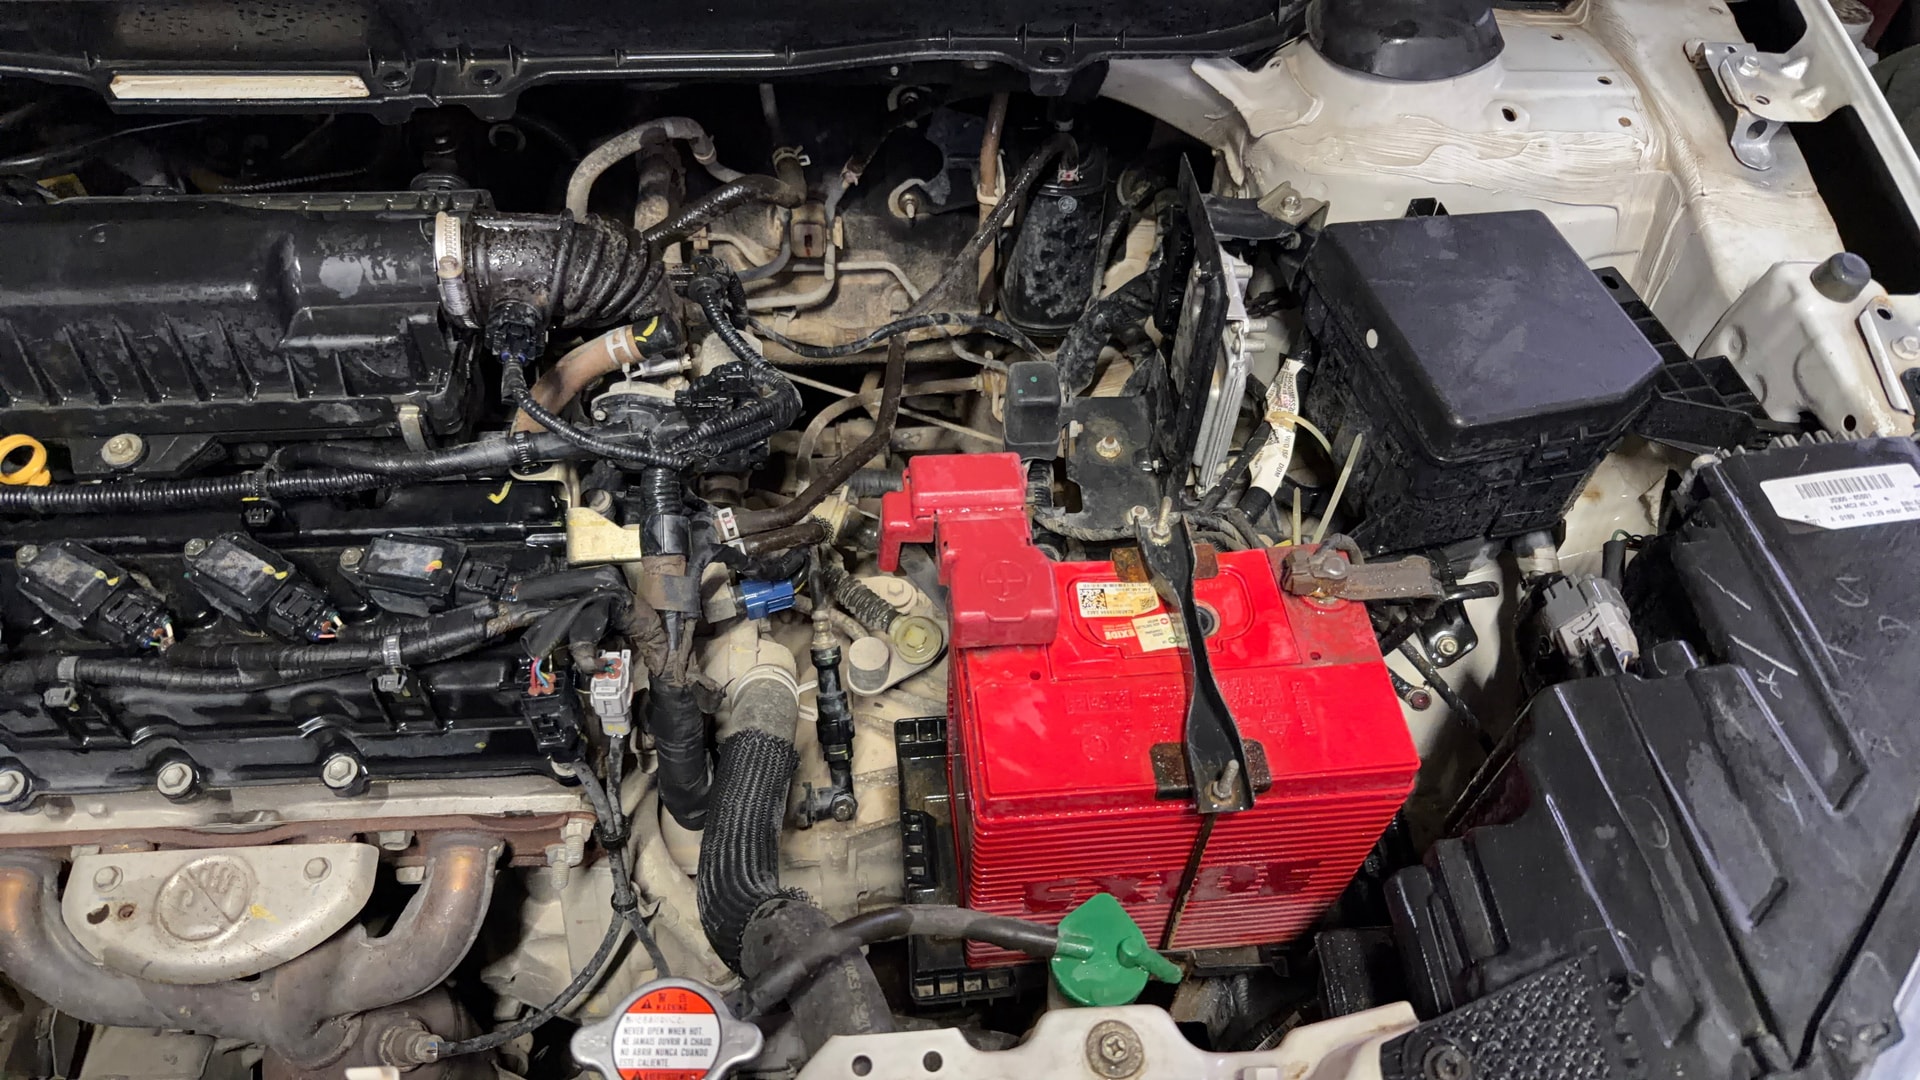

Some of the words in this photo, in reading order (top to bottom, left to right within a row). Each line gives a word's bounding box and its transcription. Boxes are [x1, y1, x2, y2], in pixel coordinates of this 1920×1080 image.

[1274, 463, 1285, 478] DOM
[1104, 630, 1136, 641] EXIDE
[623, 1027, 645, 1035] NEVER
[647, 1027, 664, 1035] OPEN
[667, 1027, 686, 1035] WHEN
[632, 1037, 655, 1045] JAMAIS
[657, 1037, 680, 1045] OUVRIR
[620, 1048, 630, 1056] NO
[632, 1048, 652, 1056] ABRIR
[655, 1048, 678, 1056] NUNCA
[681, 1047, 709, 1056] CUANDO
